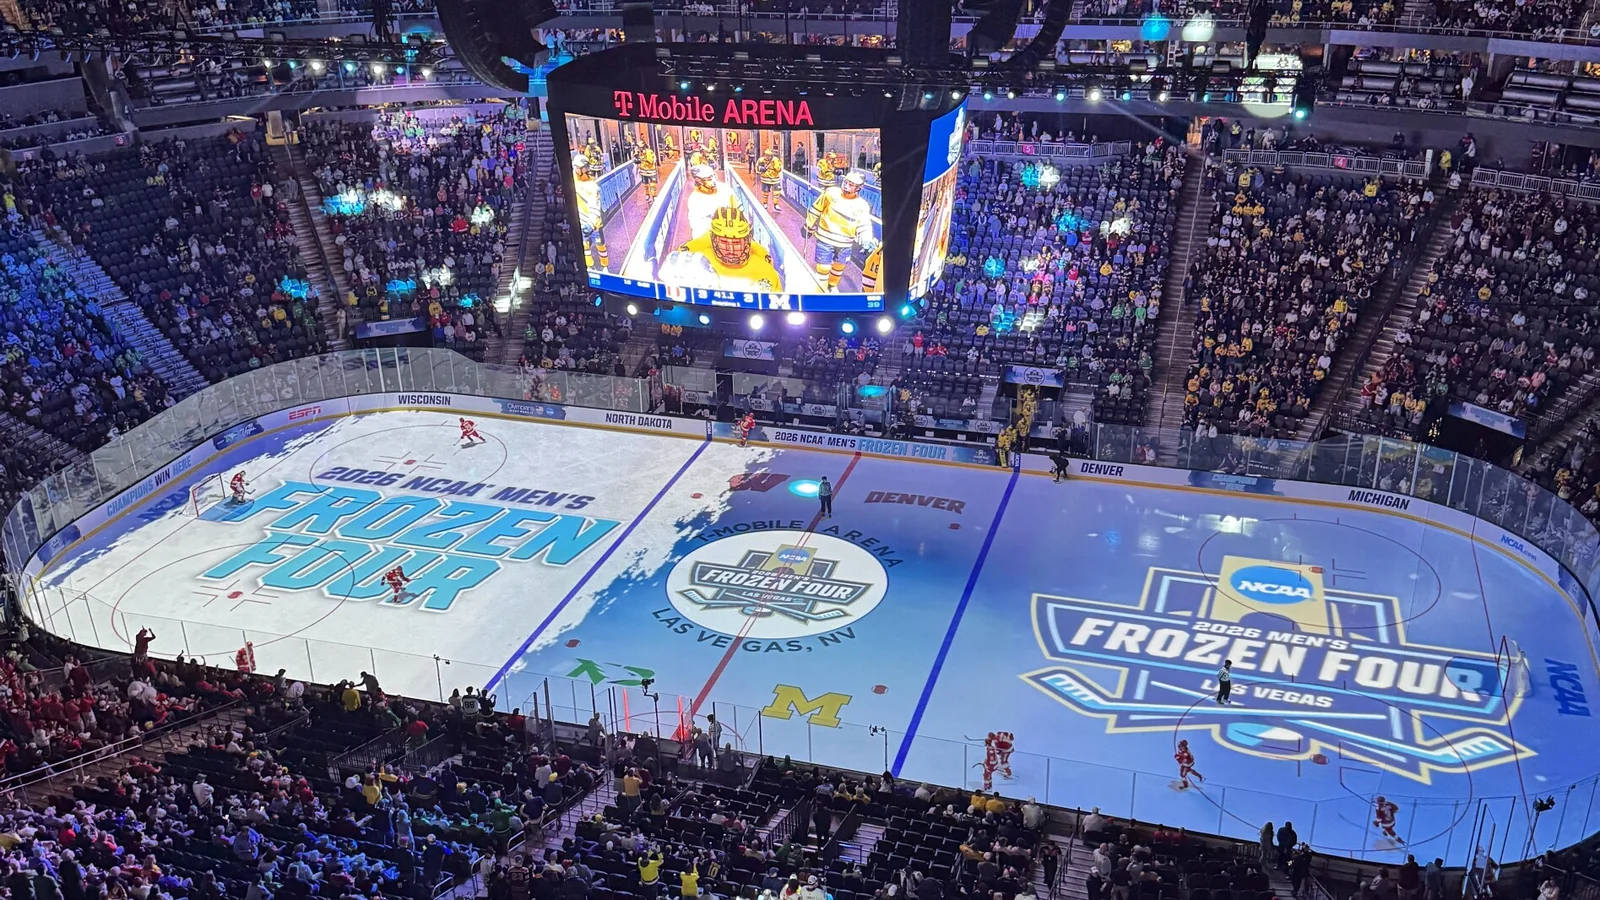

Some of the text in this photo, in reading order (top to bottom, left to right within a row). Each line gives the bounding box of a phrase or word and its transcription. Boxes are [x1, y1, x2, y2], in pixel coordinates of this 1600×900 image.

[637, 93, 715, 122] Mobile
[723, 99, 814, 125] ARENA
[725, 220, 734, 228] 10
[288, 406, 321, 420] ESPN
[398, 394, 451, 405] WISCONSIN
[605, 412, 672, 429] NORTH DAKOTA
[775, 431, 946, 460] 2026 NCAA MEN'S FROZEN FOUR
[1081, 462, 1124, 476] DENVER
[107, 455, 192, 517] CHAMPIONS WIN HERE
[315, 466, 597, 511] 2026 NCAA MEN'S
[1348, 489, 1410, 510] MICHIGAN
[864, 491, 966, 514] DENVER
[214, 480, 621, 568] FROZEN
[693, 519, 904, 568] T-MOBILE ARENA
[1500, 534, 1537, 561] NCAA.com
[196, 530, 502, 614] FOUR
[701, 569, 854, 600] FROZEN FOUR
[762, 594, 792, 602] VEGAS
[1238, 580, 1313, 600] NCAA
[652, 607, 694, 635] LAS
[822, 627, 857, 647] NV
[1192, 620, 1349, 650] 2026 MEN'S
[1070, 617, 1485, 702] FROZEN FOUR
[1253, 686, 1334, 709] VEGAS
[1544, 658, 1592, 717] NCAA
[761, 684, 853, 728] M
